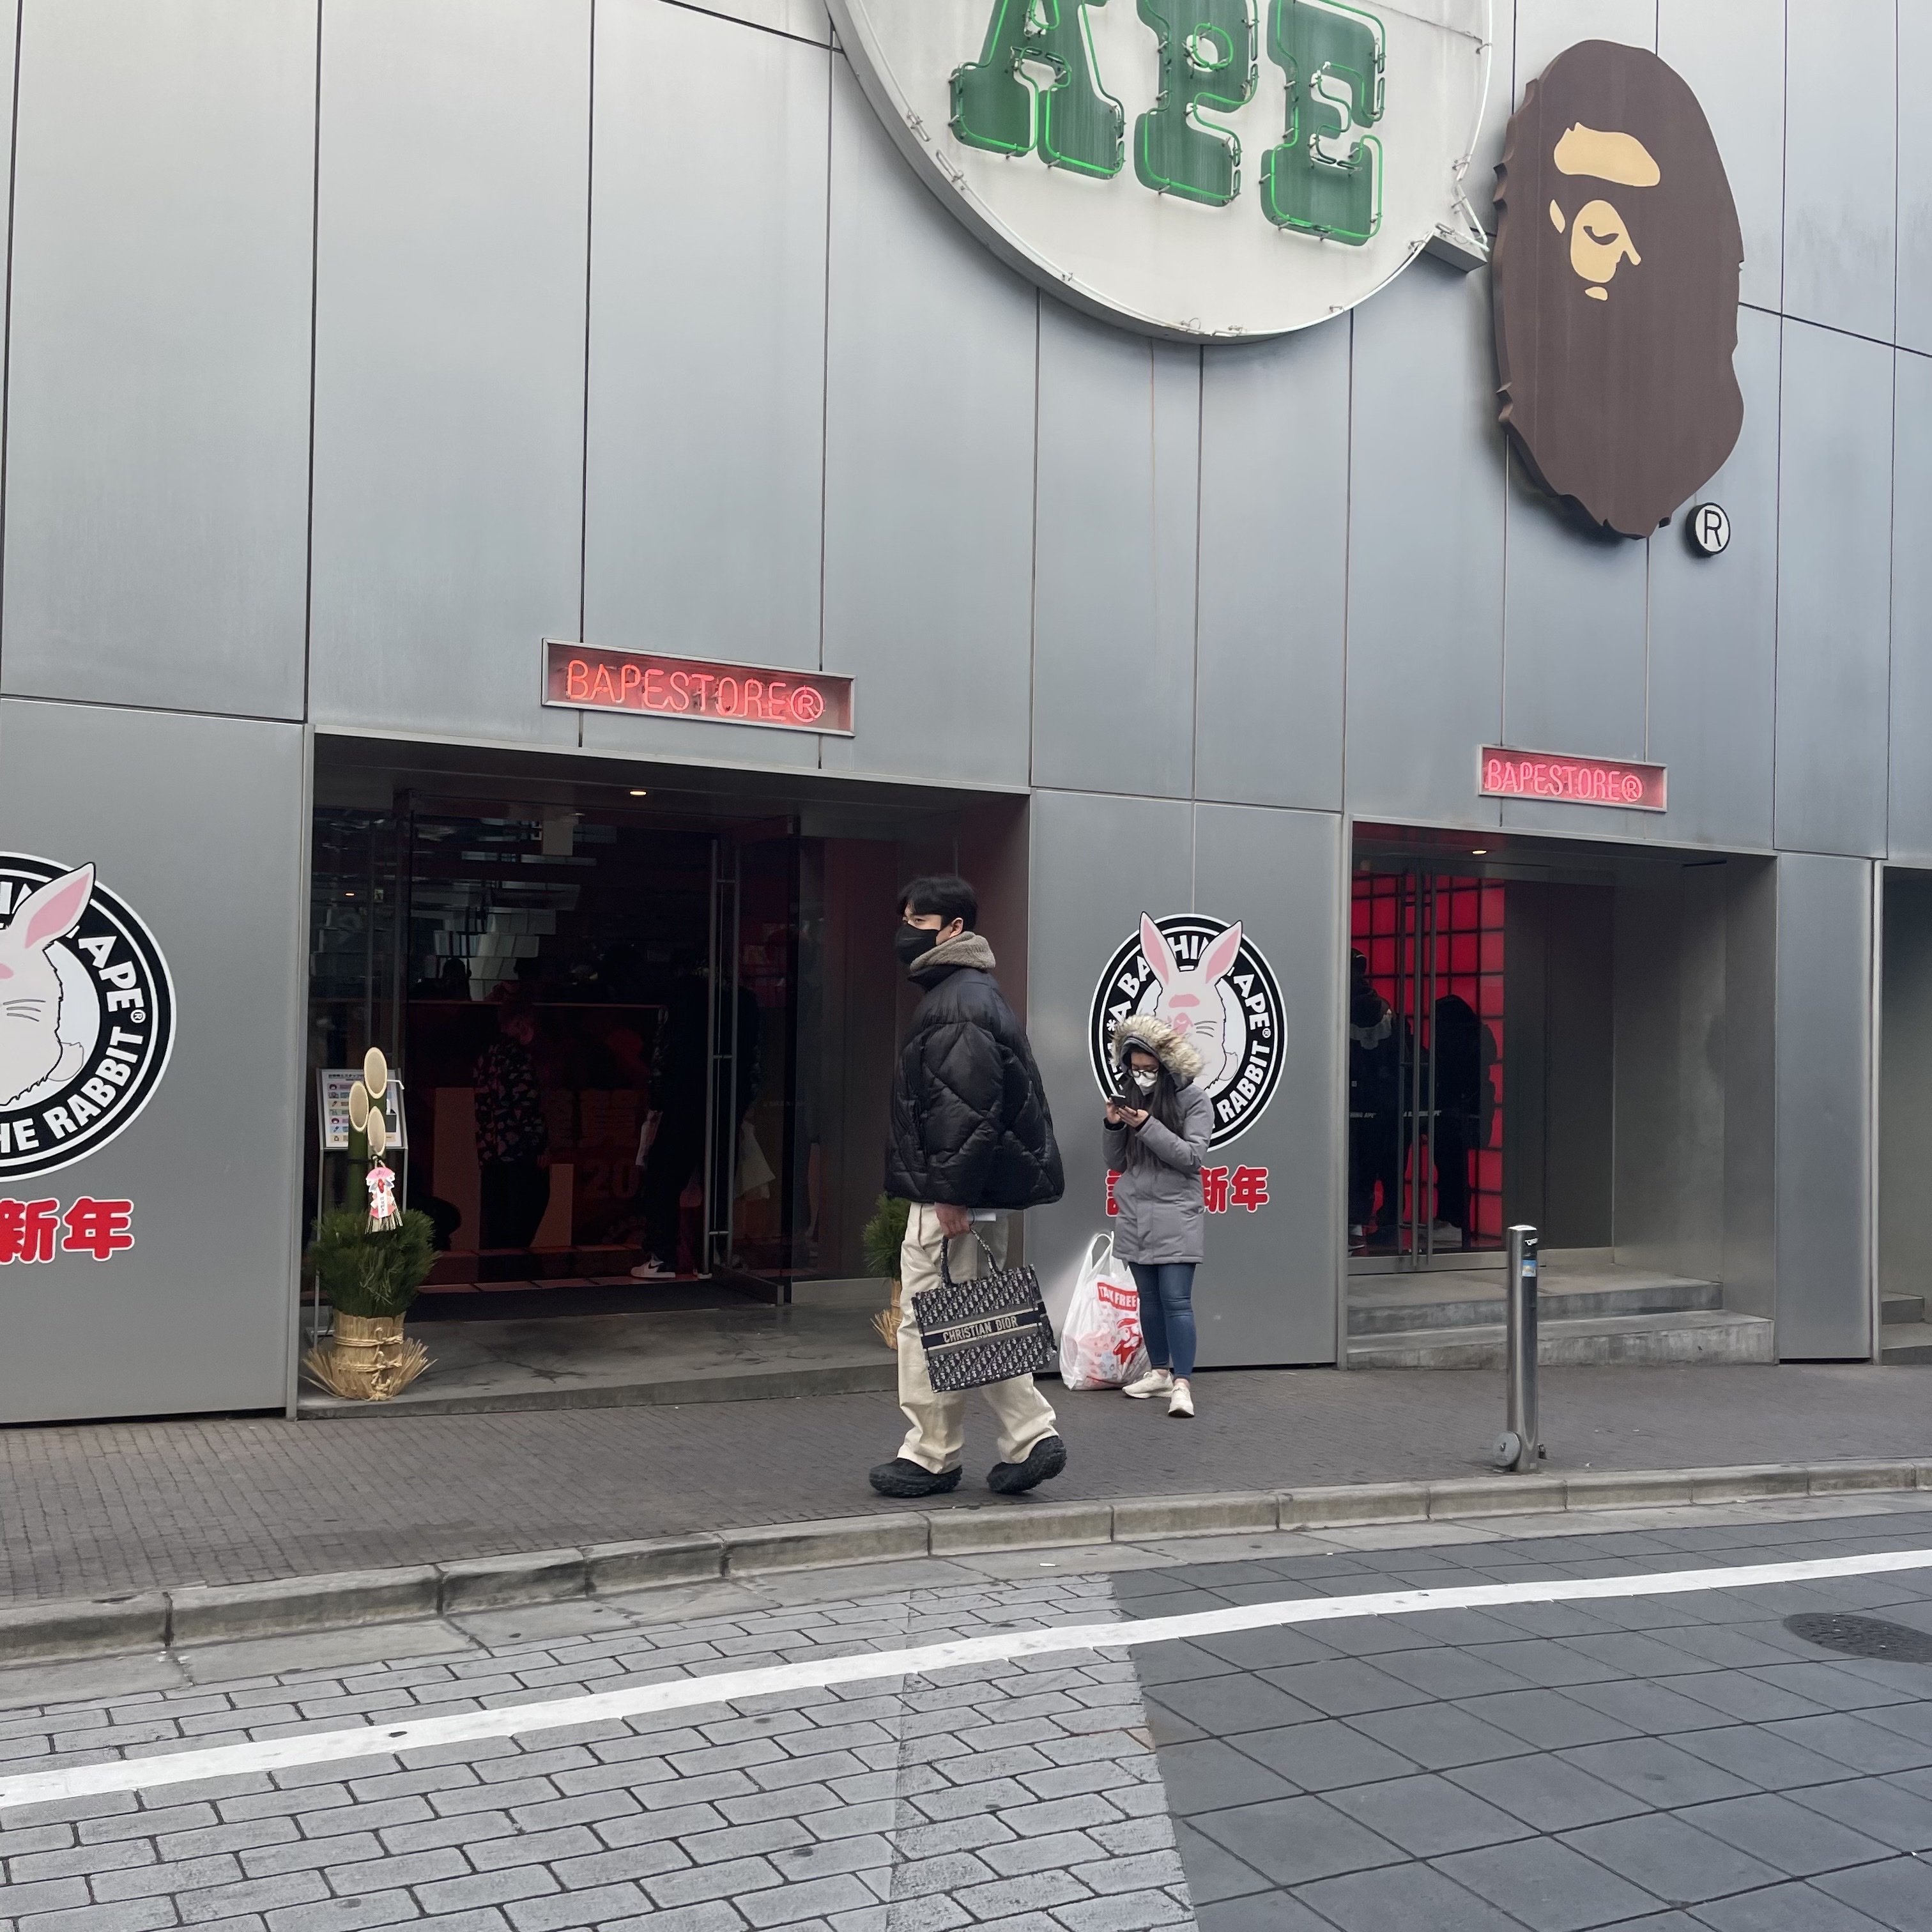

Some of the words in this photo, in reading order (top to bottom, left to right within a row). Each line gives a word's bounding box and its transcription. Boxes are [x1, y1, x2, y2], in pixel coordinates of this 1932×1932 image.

[950, 0, 1385, 247] APE
[42, 1026, 144, 1139] RABBIT
[1216, 1040, 1270, 1123] RABBIT
[942, 1321, 992, 1343] CHRISTIAN
[995, 1316, 1019, 1331] DIOR
[1099, 1285, 1114, 1303] TAX
[1114, 1291, 1137, 1308] FREE
